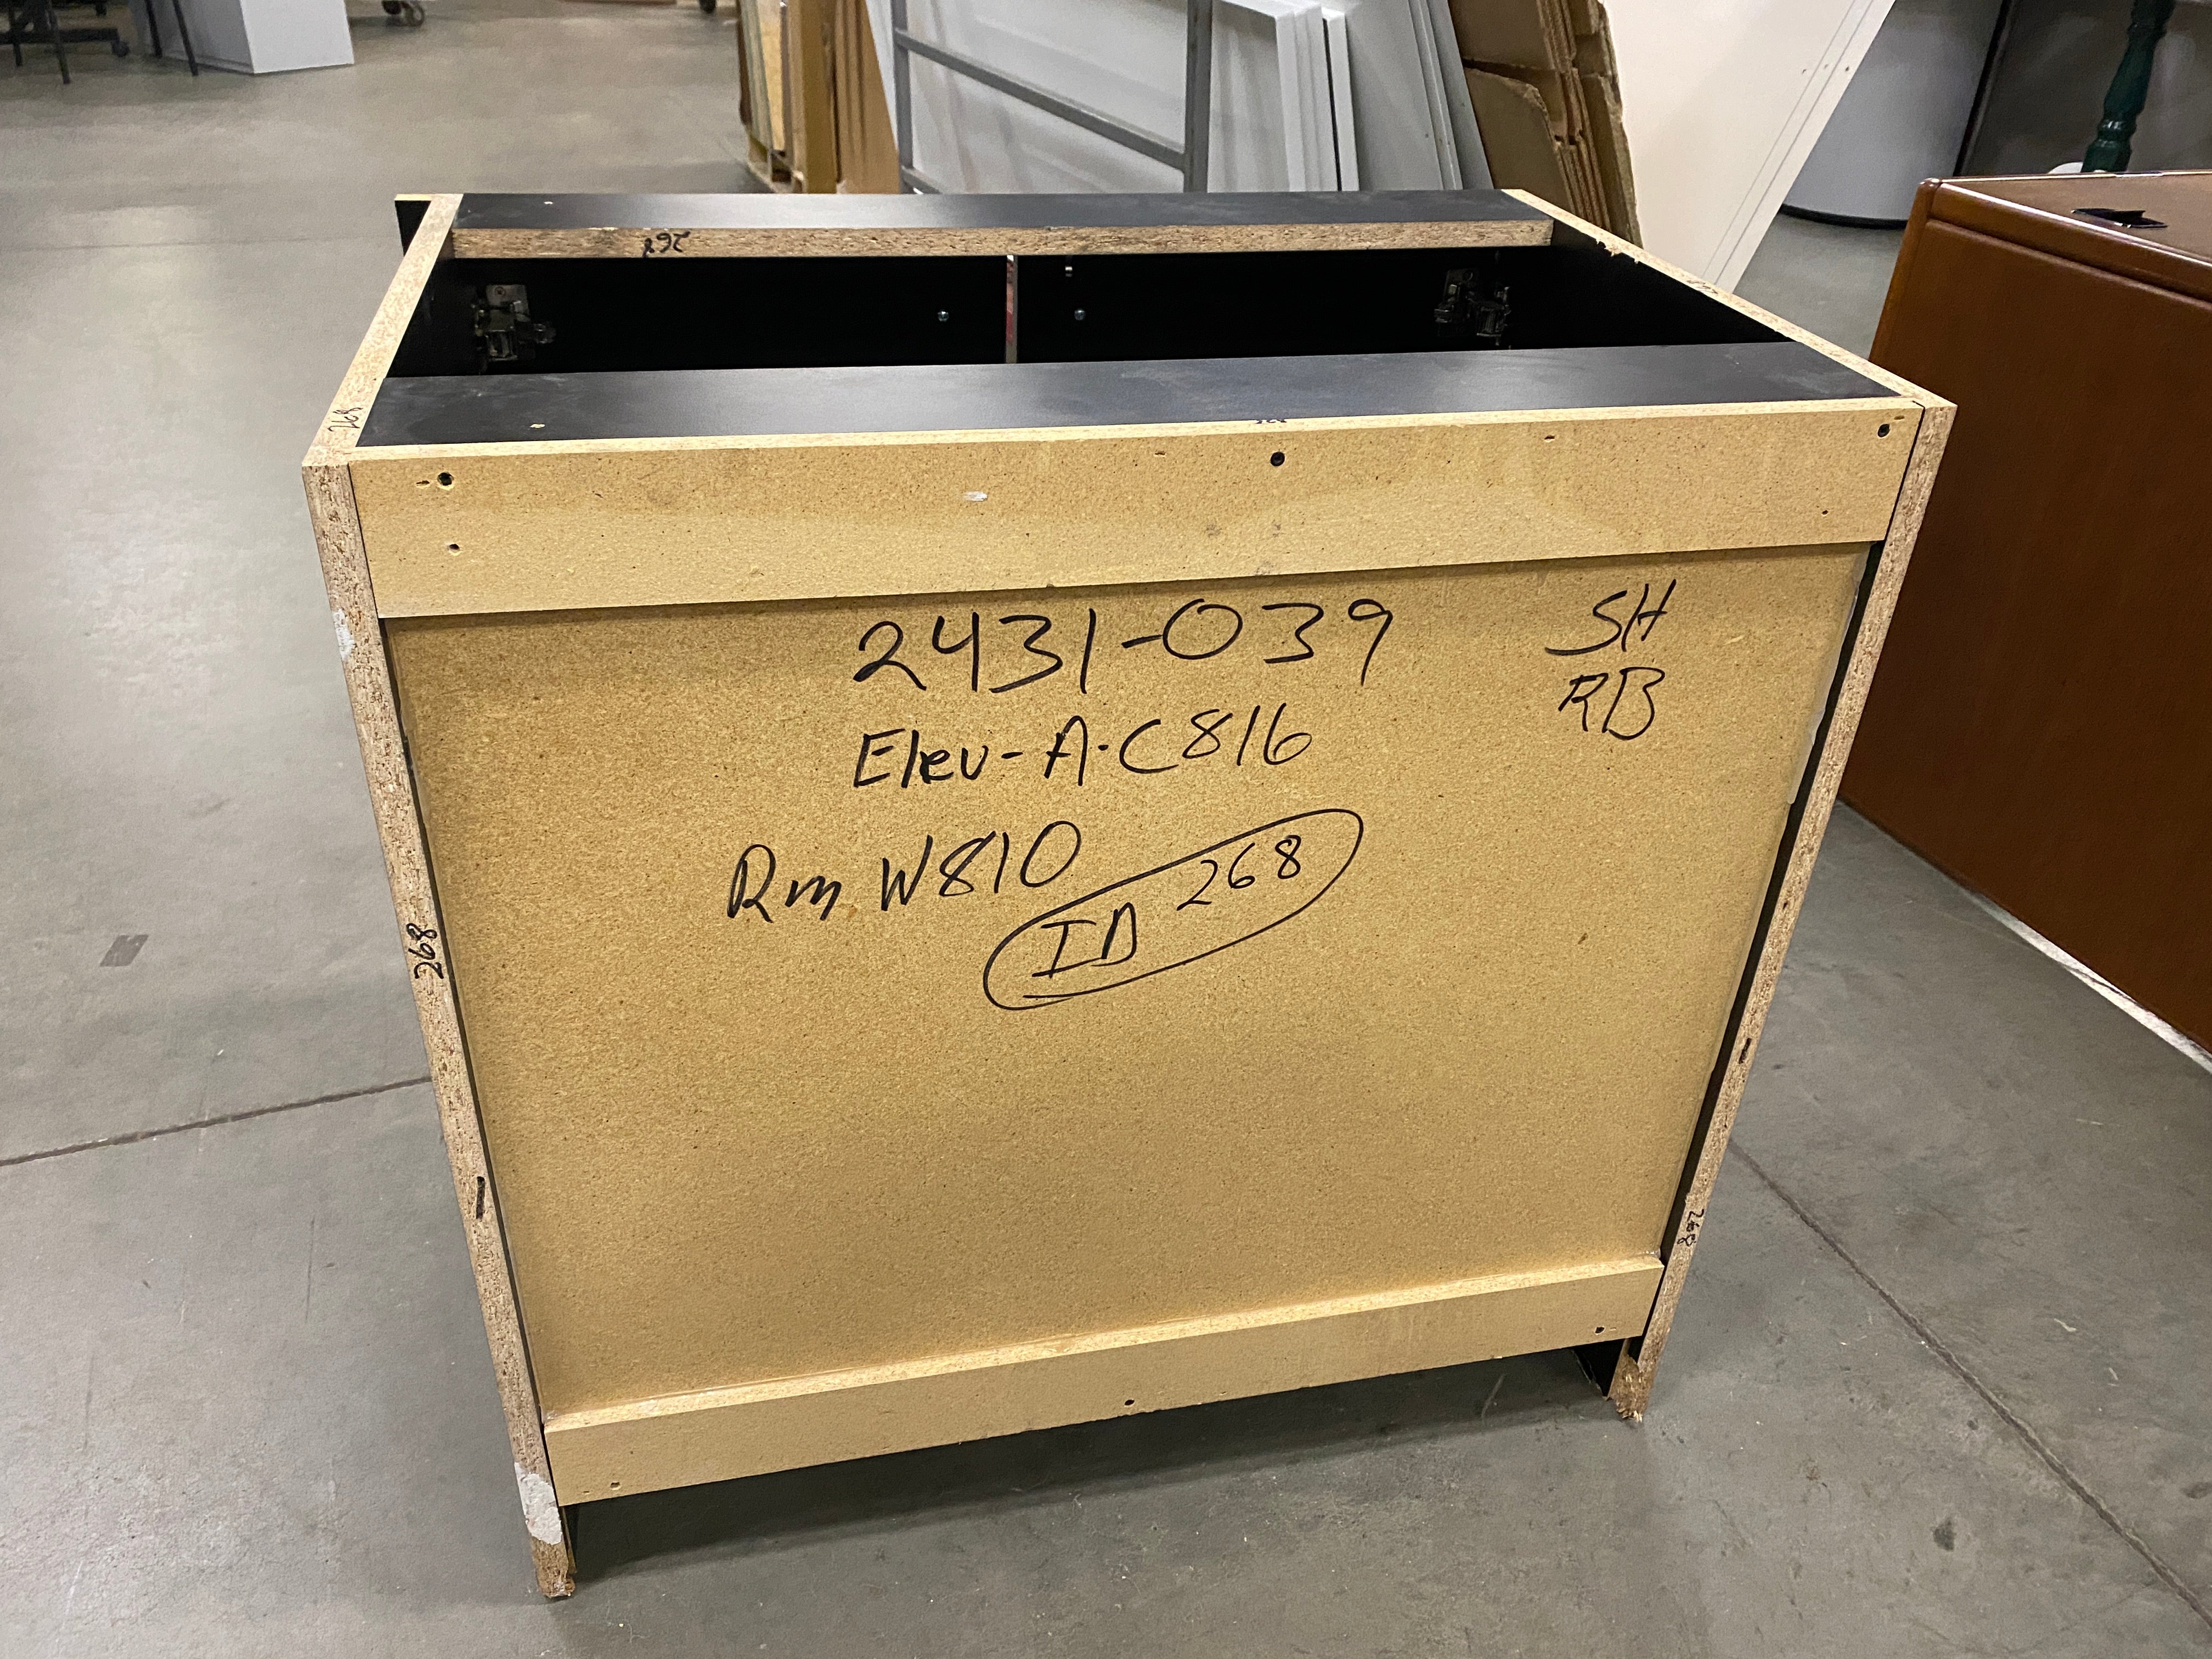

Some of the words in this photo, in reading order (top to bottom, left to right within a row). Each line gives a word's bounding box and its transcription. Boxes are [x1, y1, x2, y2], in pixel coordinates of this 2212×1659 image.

[852, 598, 1395, 695] 2431-039
[1544, 578, 1677, 656] SH
[1557, 666, 1666, 741] RB
[726, 843, 842, 924] Rm
[880, 820, 1082, 912] W810
[1031, 901, 1138, 980] ID
[1176, 834, 1302, 912] 268
[405, 923, 444, 979] 268
[1677, 1209, 1705, 1247] 268
